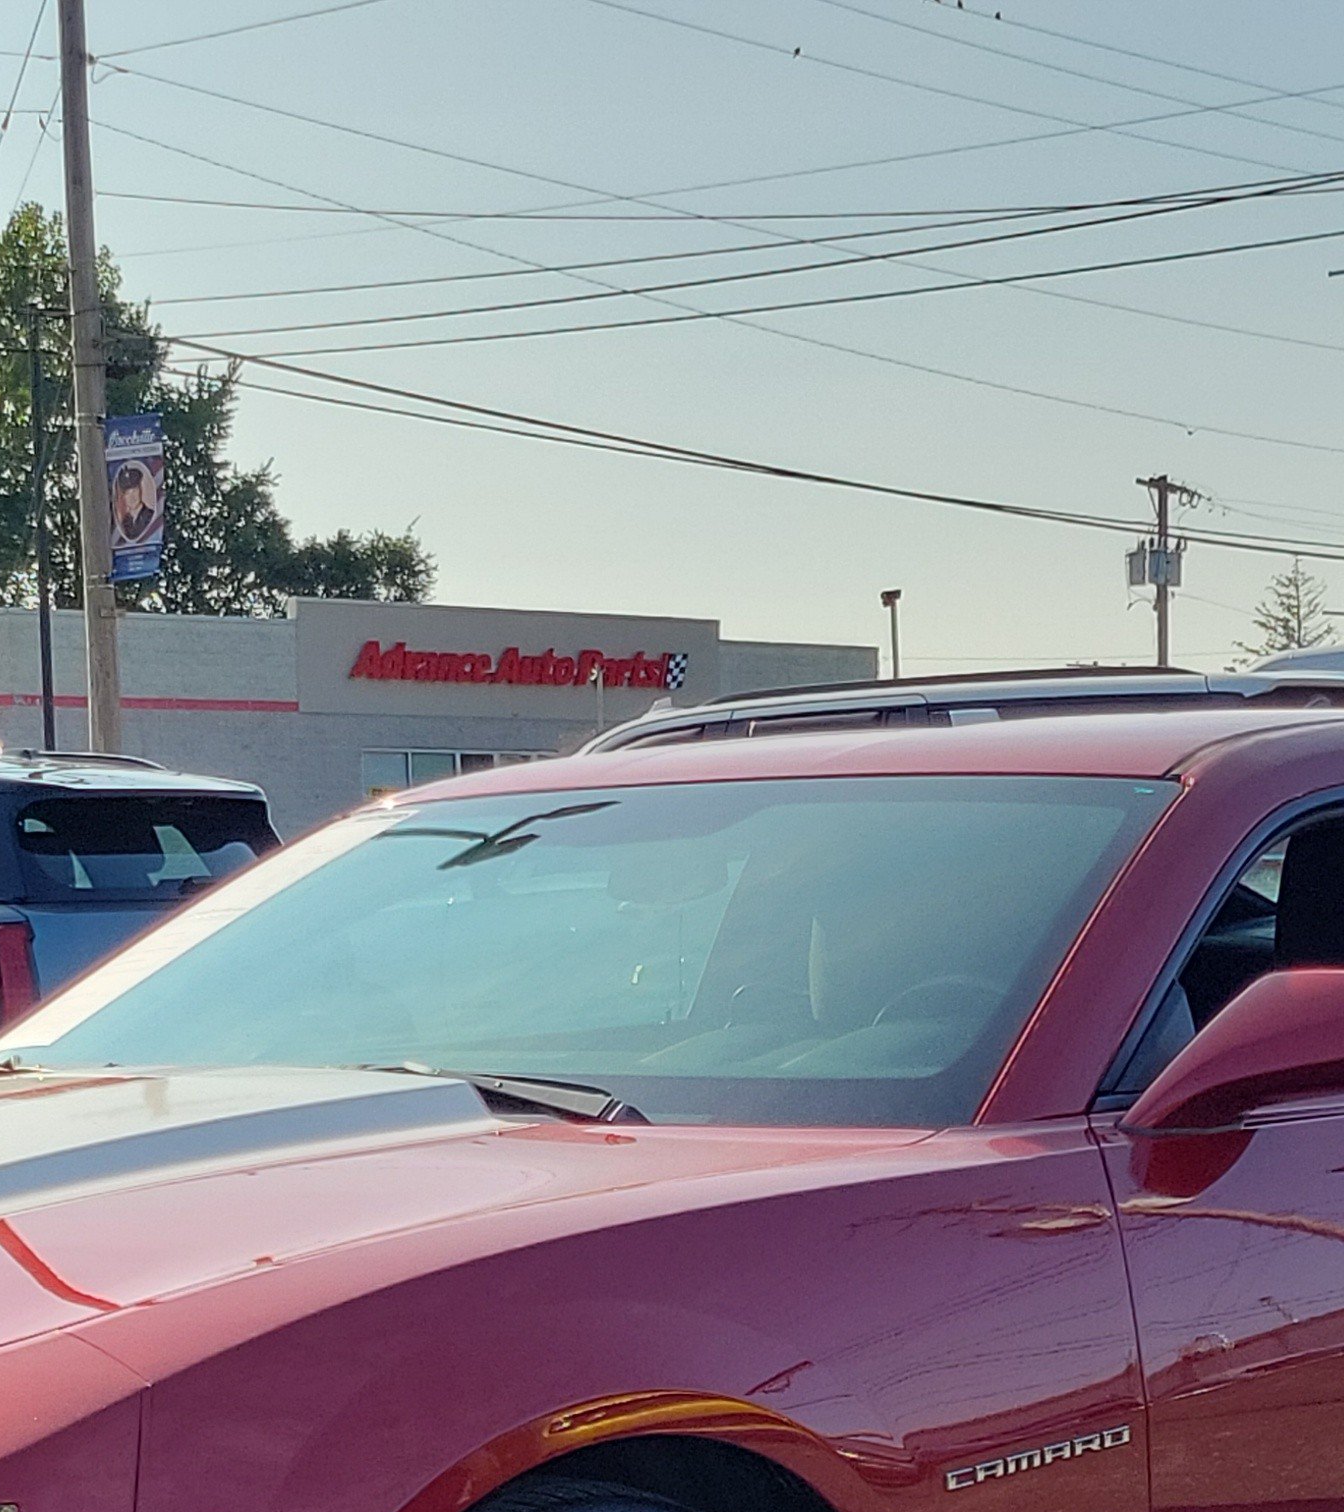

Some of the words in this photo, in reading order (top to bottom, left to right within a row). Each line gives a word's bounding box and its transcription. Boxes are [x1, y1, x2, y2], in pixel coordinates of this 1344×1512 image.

[350, 640, 492, 683] Advance
[490, 647, 573, 686] Auto
[573, 650, 662, 689] Parts
[945, 1424, 1131, 1491] CAMARO
